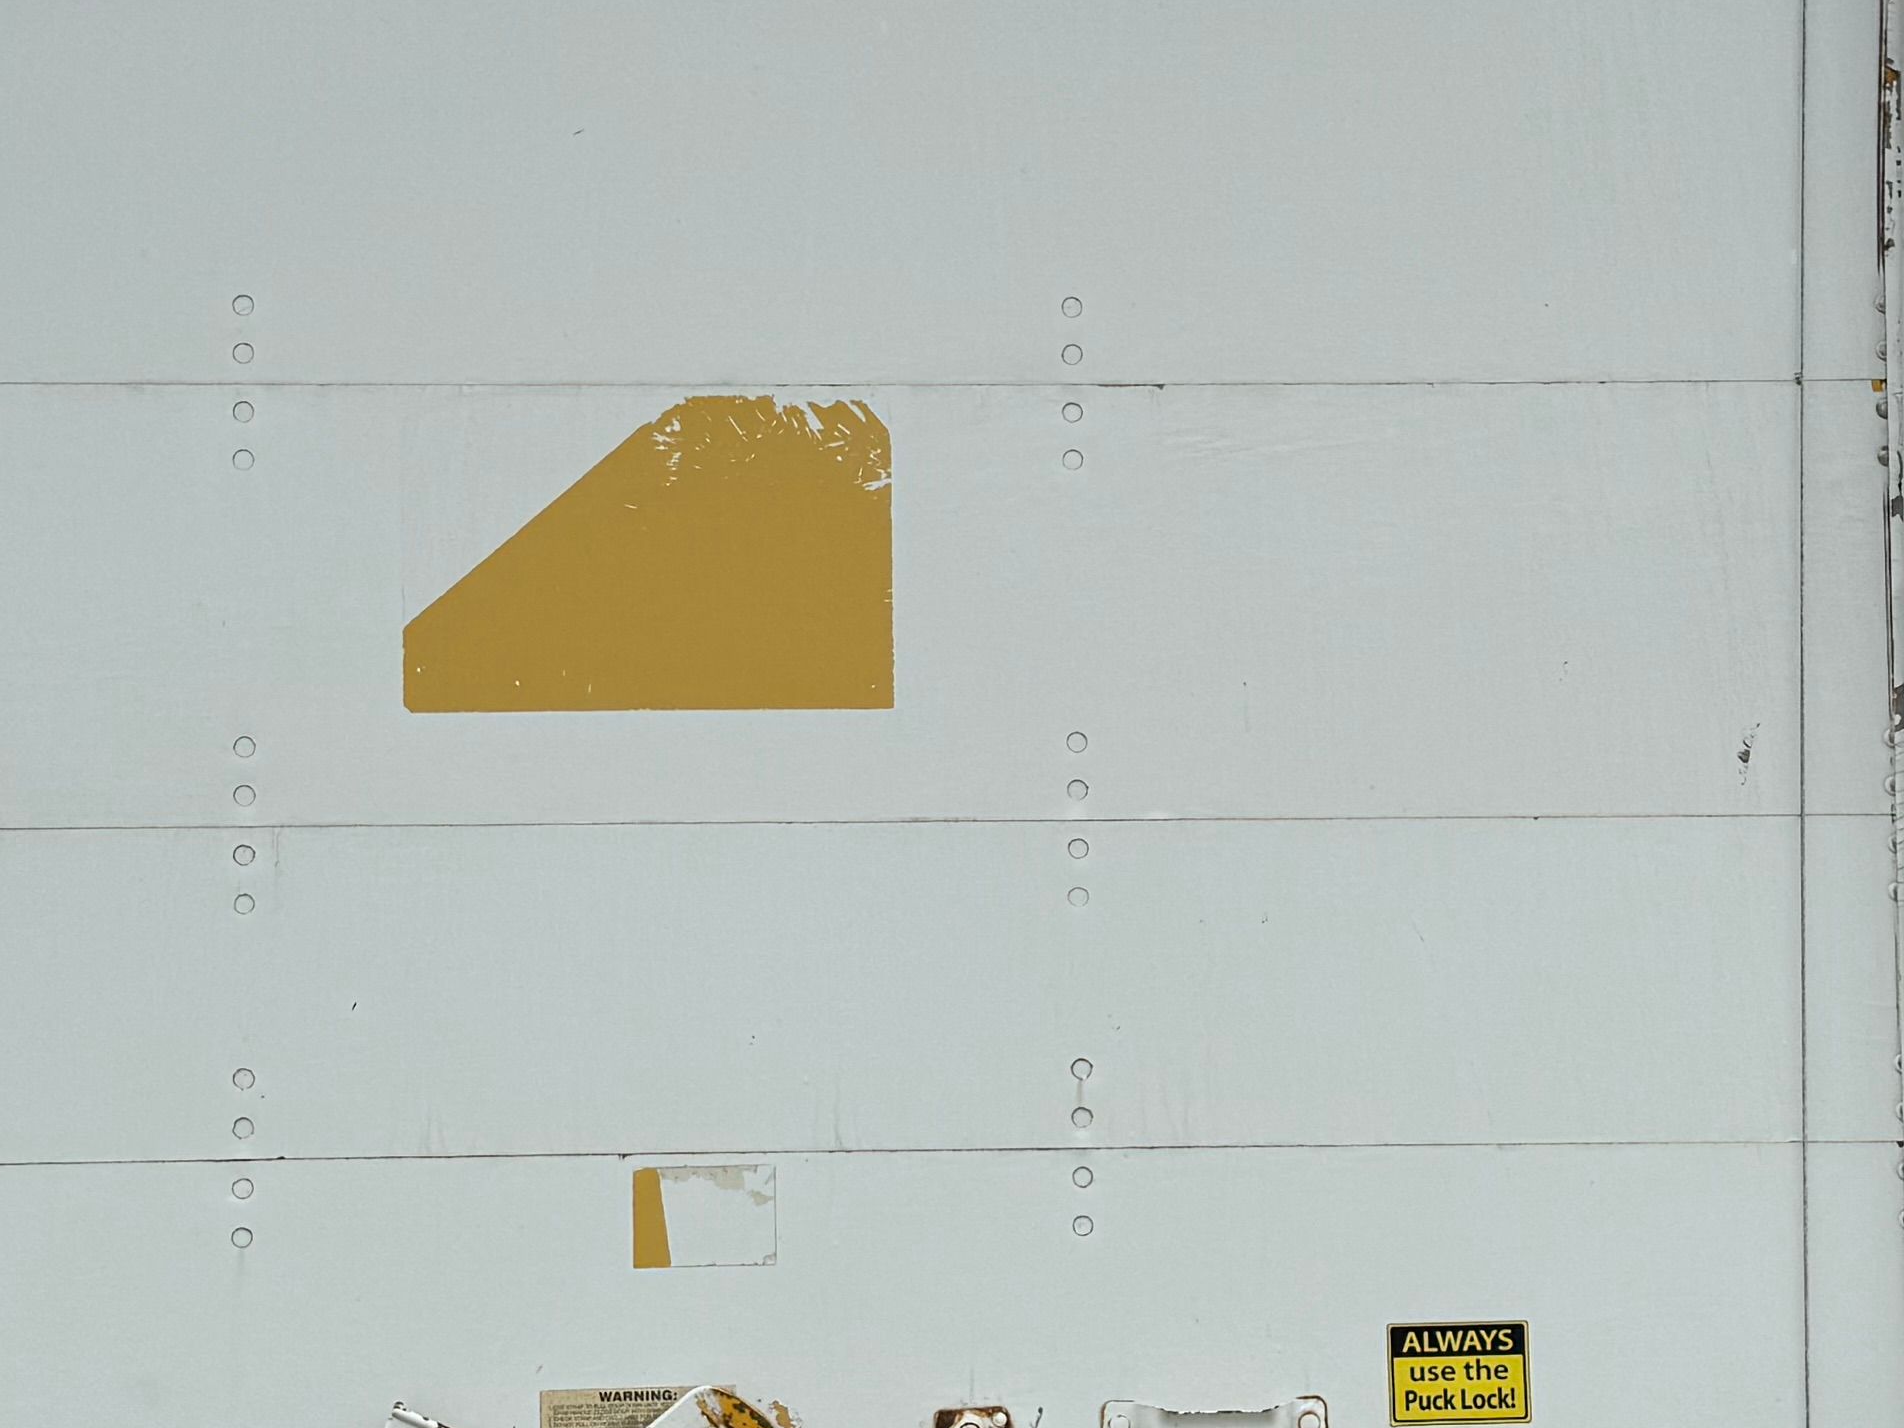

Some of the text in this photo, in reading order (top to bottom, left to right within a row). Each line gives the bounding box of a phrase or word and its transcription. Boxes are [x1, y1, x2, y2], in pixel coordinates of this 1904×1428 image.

[1402, 1329, 1514, 1353] ALWAYS
[1410, 1358, 1509, 1382] use the
[598, 1389, 678, 1403] WARNING:
[1405, 1386, 1516, 1412] Puck Lock!
